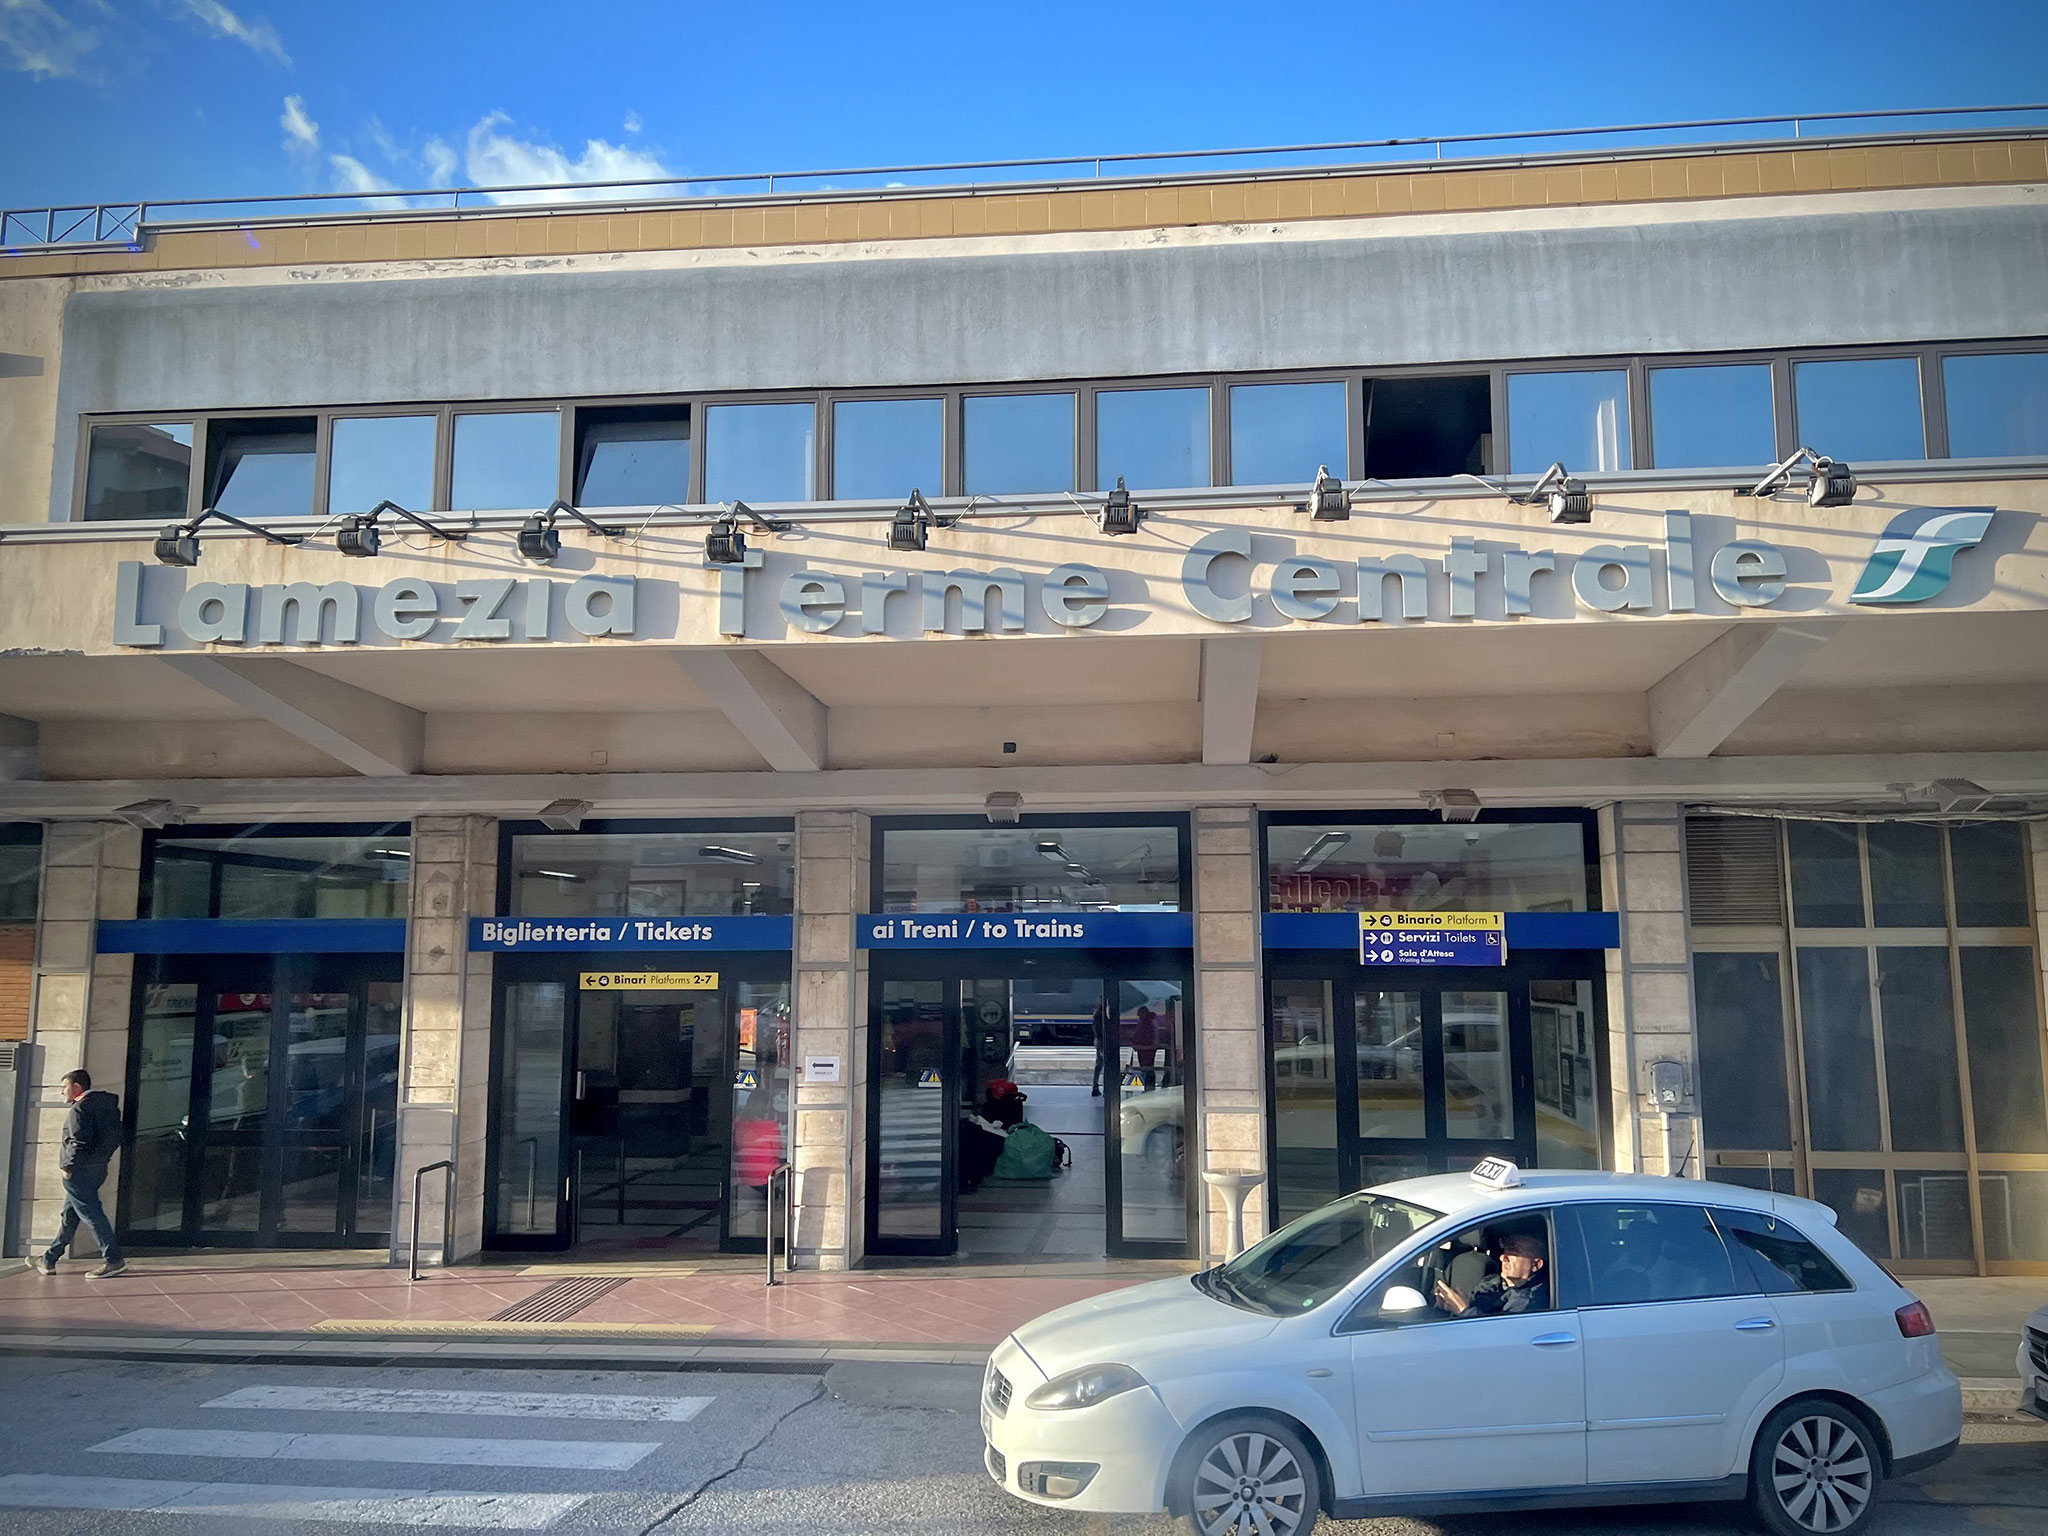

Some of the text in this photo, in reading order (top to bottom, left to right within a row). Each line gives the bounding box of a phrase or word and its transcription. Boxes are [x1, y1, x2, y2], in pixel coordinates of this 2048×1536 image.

[113, 509, 1788, 648] Lamezia Terme Centrale
[1397, 914, 1499, 925] Binario Platform 1
[482, 921, 713, 946] Biglietteria / Tickets
[872, 919, 1084, 939] ai Treni / to Trains
[1398, 931, 1477, 943] Servizi Toilets
[1398, 949, 1455, 958] Sala d'Attesa
[613, 973, 712, 985] Binari Platforms 2-7
[1475, 1161, 1506, 1180] TAXI
